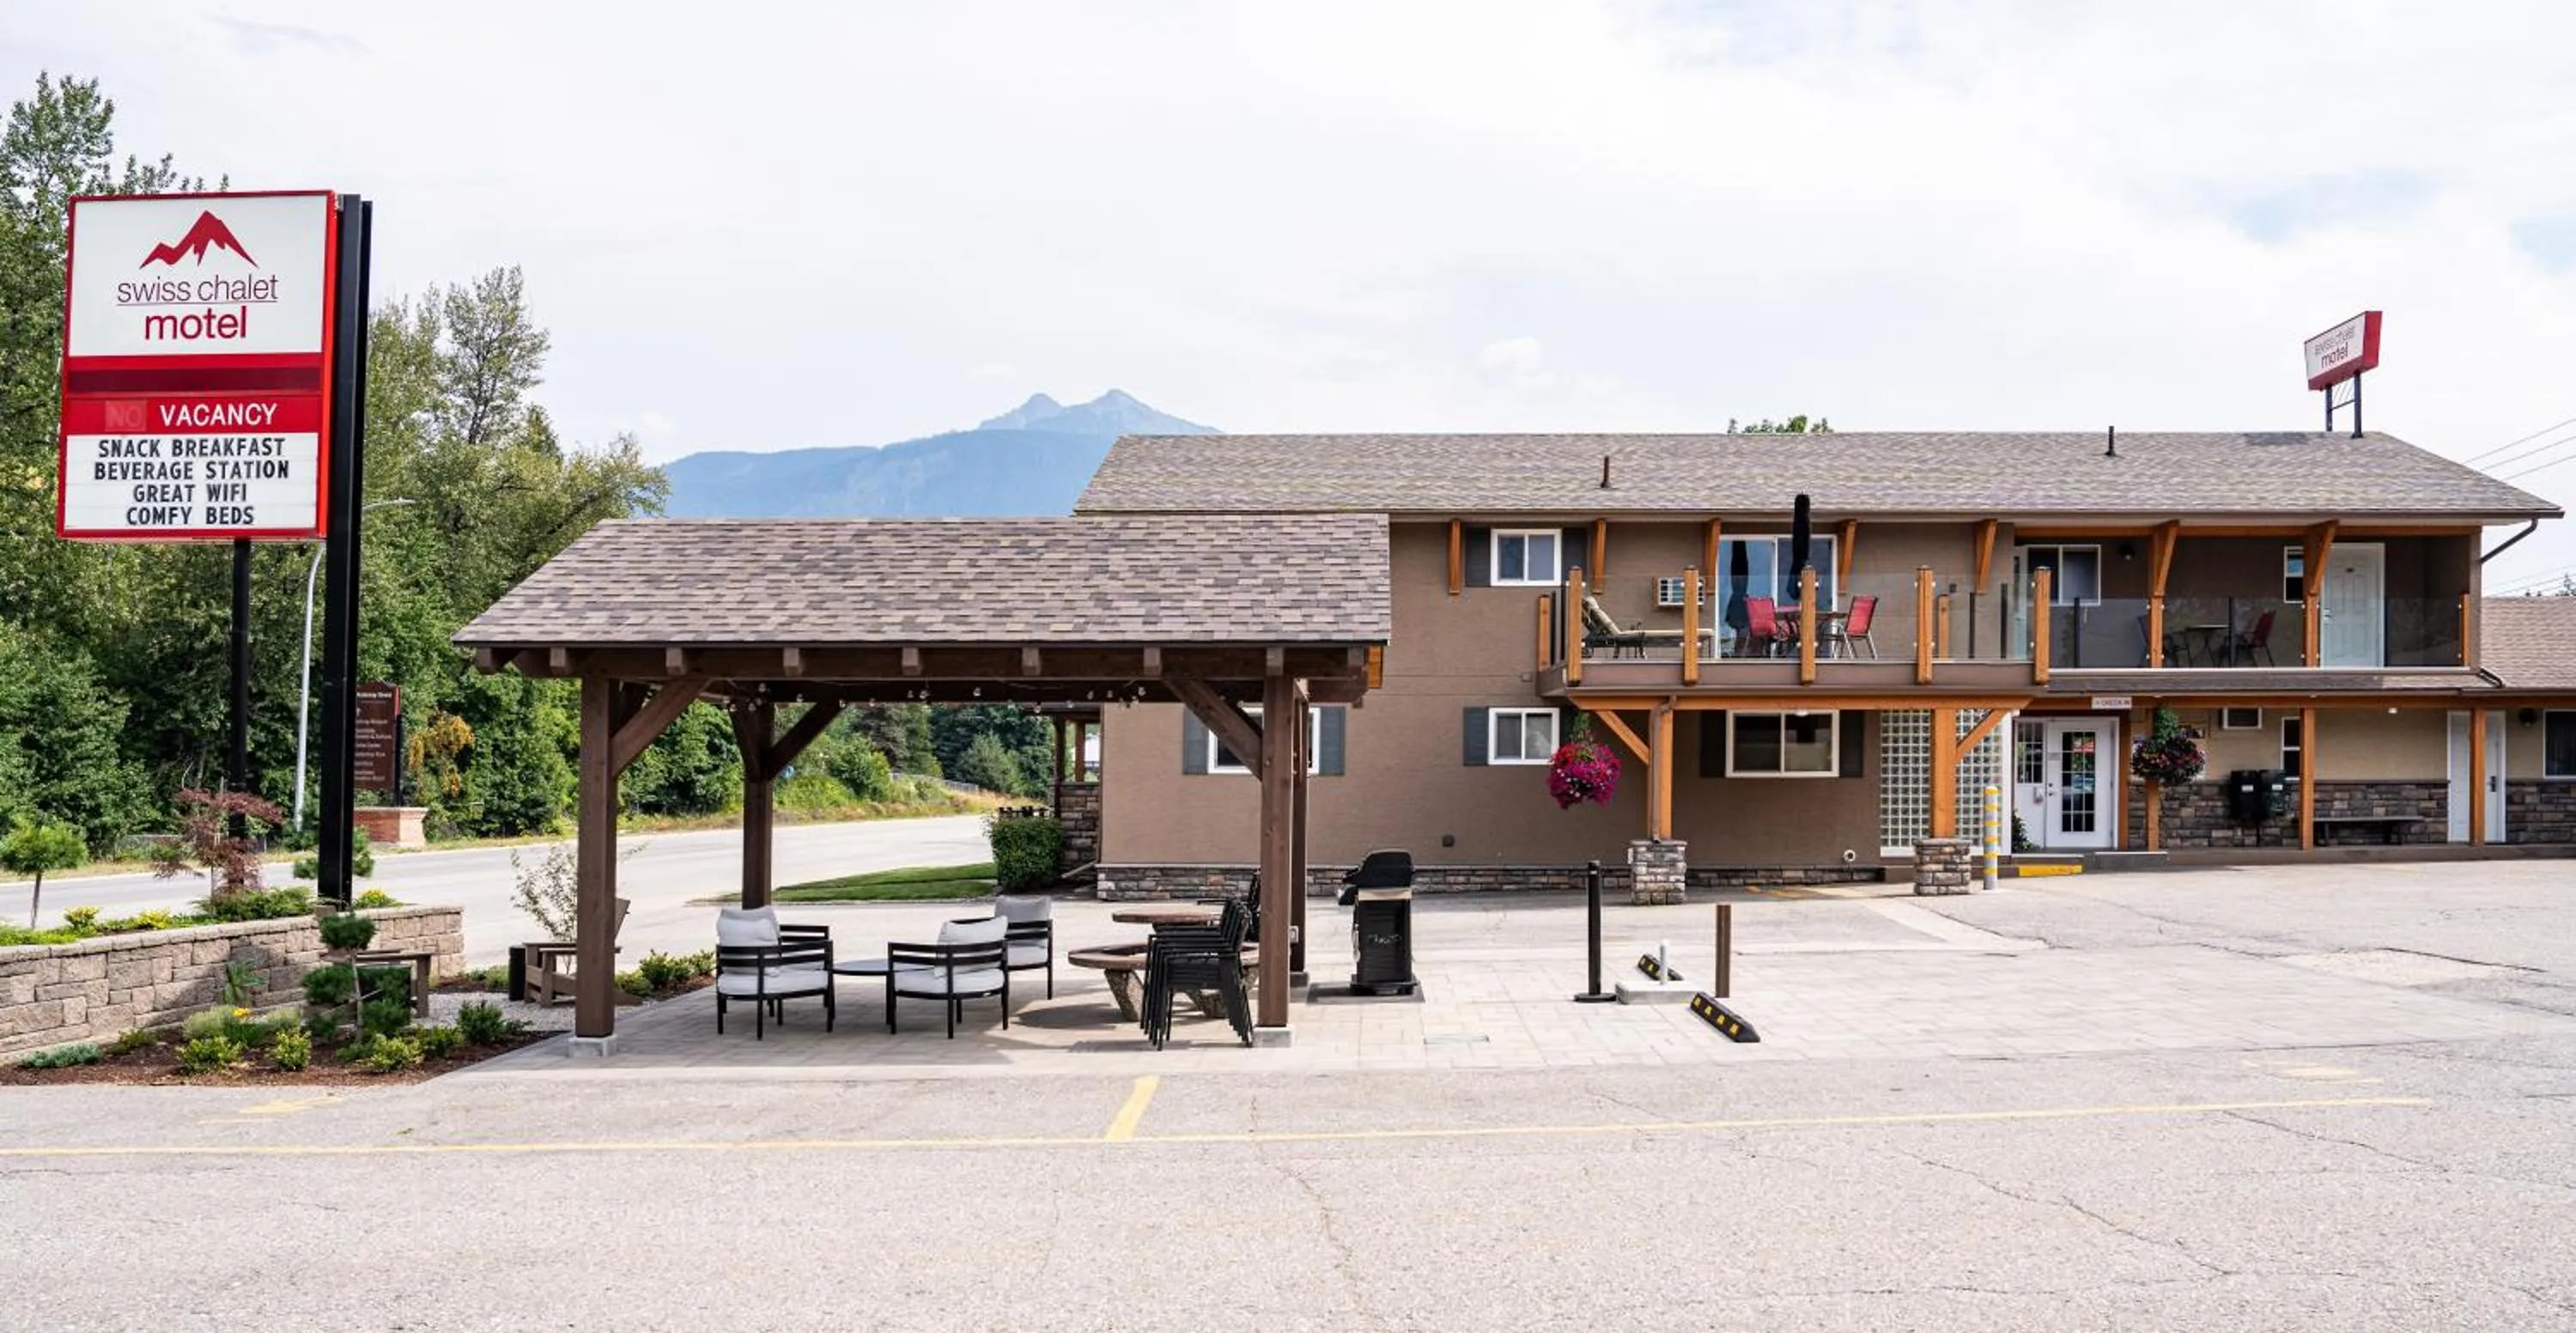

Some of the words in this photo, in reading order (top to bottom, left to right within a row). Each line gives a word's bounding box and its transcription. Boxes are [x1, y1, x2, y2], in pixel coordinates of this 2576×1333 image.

[118, 276, 191, 303] swiss
[197, 273, 278, 301] chalet
[144, 305, 246, 340] motel
[109, 406, 143, 427] NO
[160, 403, 277, 426] VACANCY
[99, 439, 161, 458] SNACK
[172, 437, 285, 457] BREAKFAST
[94, 461, 193, 480] BEVERAGE
[205, 460, 289, 479] STATION
[133, 484, 195, 502] GREAT
[206, 483, 247, 502] WIFI
[126, 507, 192, 525] COMFY
[205, 506, 254, 525] BEDS
